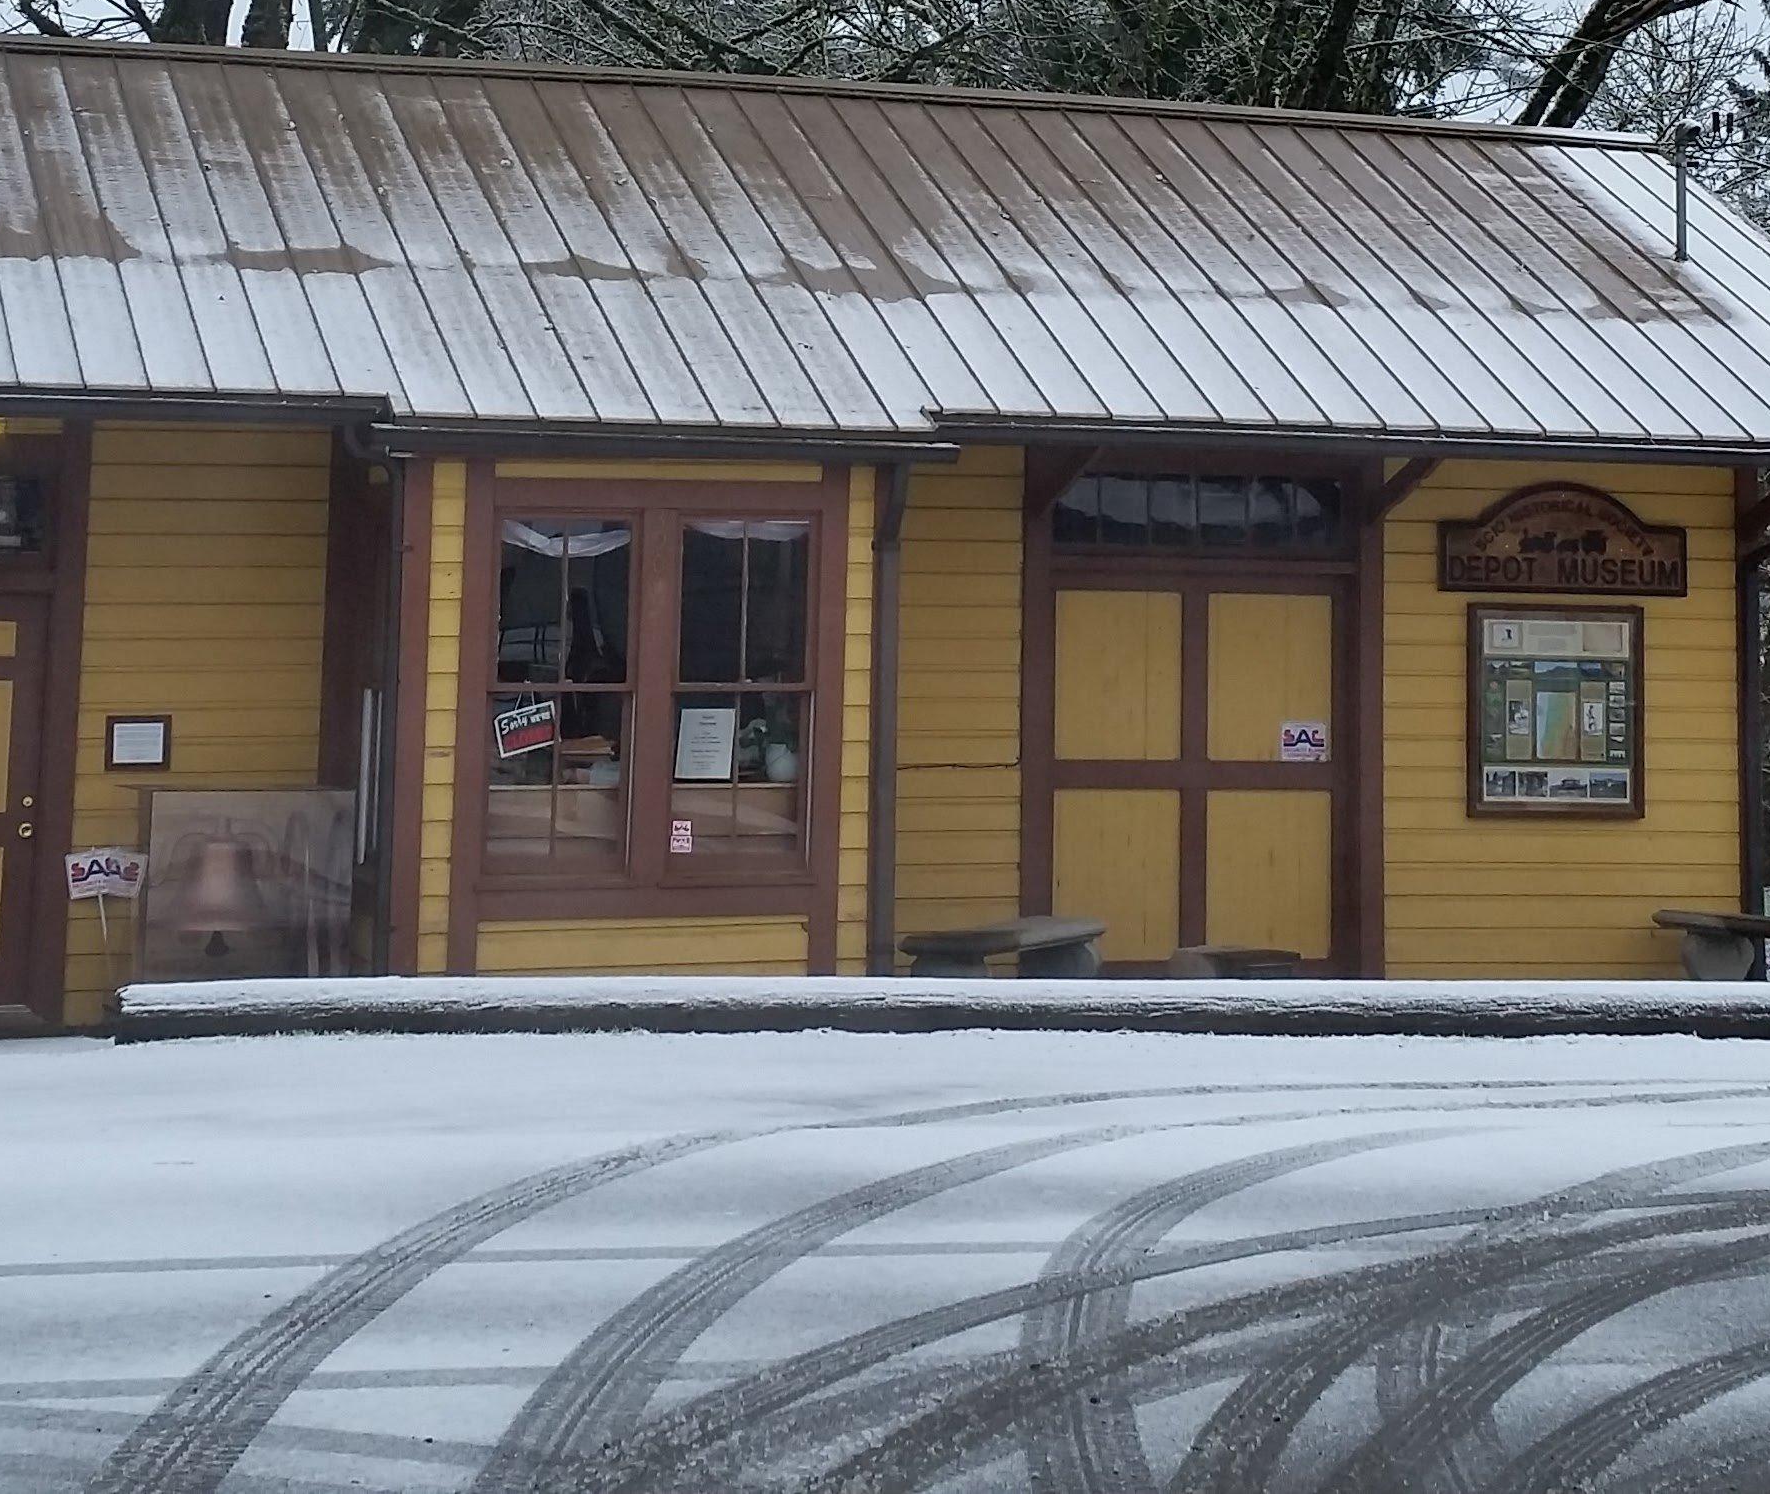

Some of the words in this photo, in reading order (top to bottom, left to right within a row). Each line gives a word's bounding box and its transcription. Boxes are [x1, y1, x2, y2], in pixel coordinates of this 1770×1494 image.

[1473, 520, 1507, 552] SCIO
[1448, 554, 1538, 583] DEPOT
[1557, 557, 1679, 587] MUSEUM
